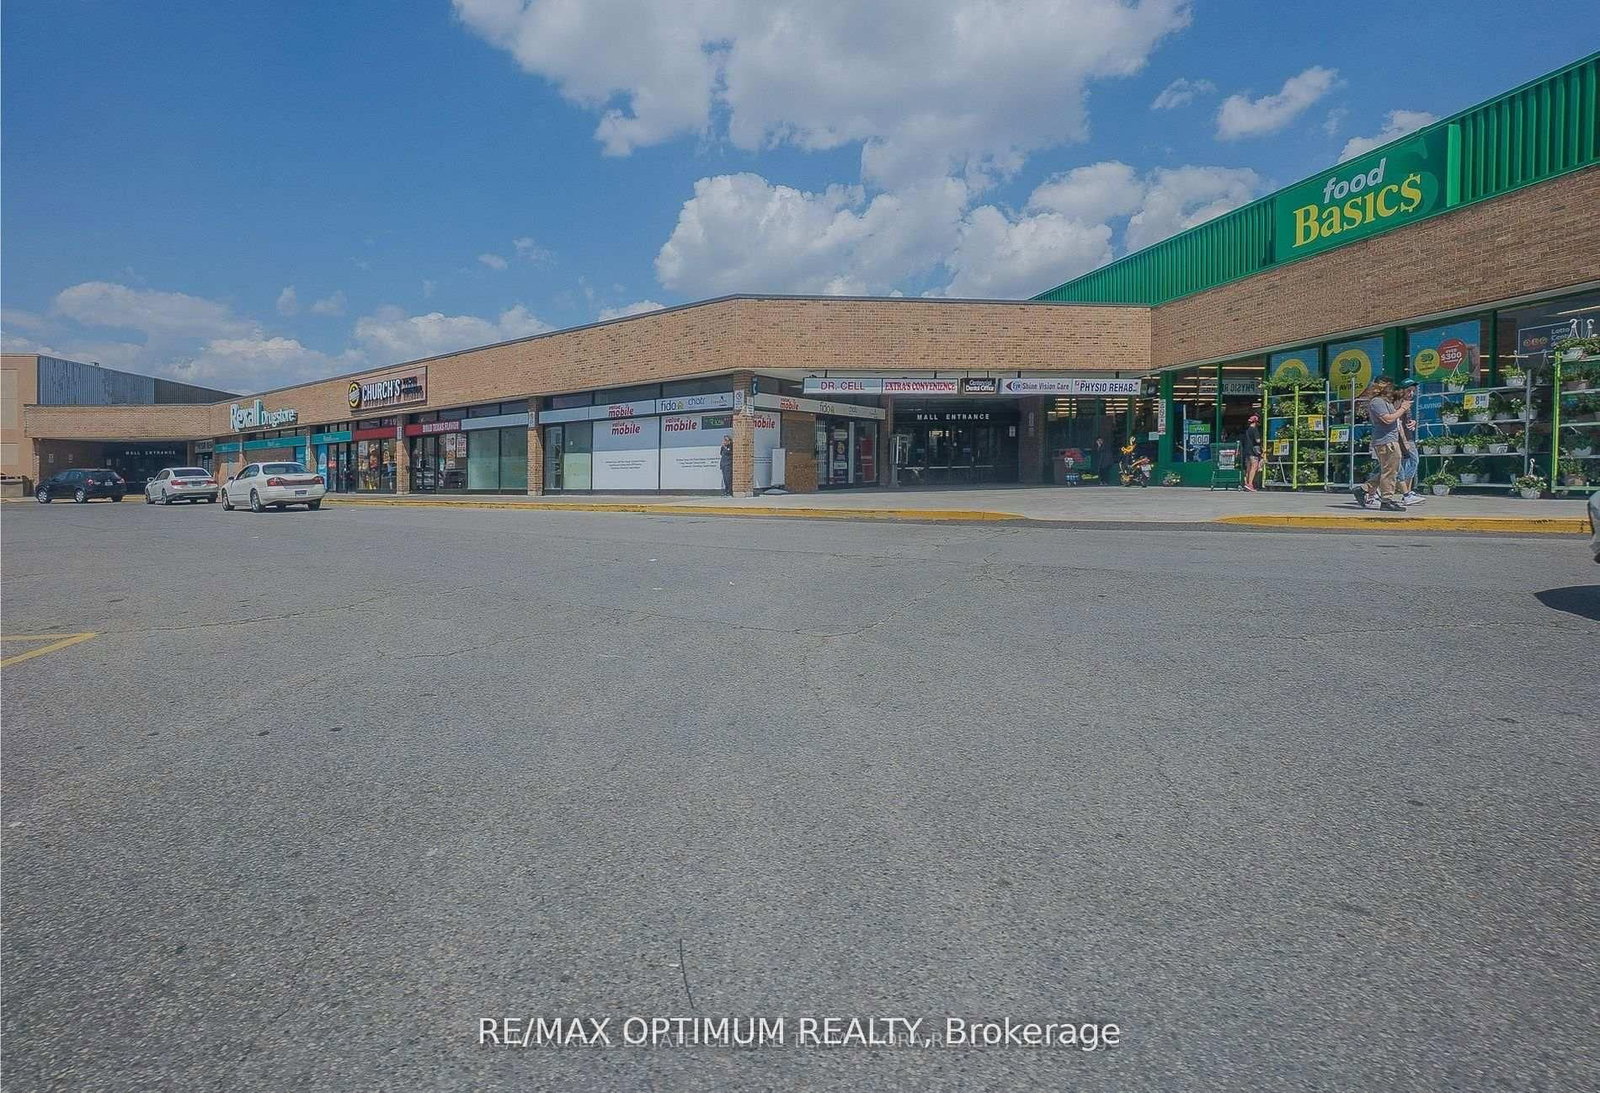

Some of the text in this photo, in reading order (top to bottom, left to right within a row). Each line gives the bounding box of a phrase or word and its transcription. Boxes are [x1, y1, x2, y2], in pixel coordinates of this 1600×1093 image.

[1323, 158, 1386, 204] food
[361, 379, 401, 401] CHURCH'S
[820, 381, 865, 391] DR. CELL
[1080, 382, 1107, 392] PHYSIO
[661, 400, 677, 411] fido
[230, 399, 262, 432] Rexall
[608, 406, 634, 417] mobile
[917, 413, 991, 421] MALL ENTRANCE
[611, 424, 641, 436] mobile
[664, 419, 698, 432] mobile
